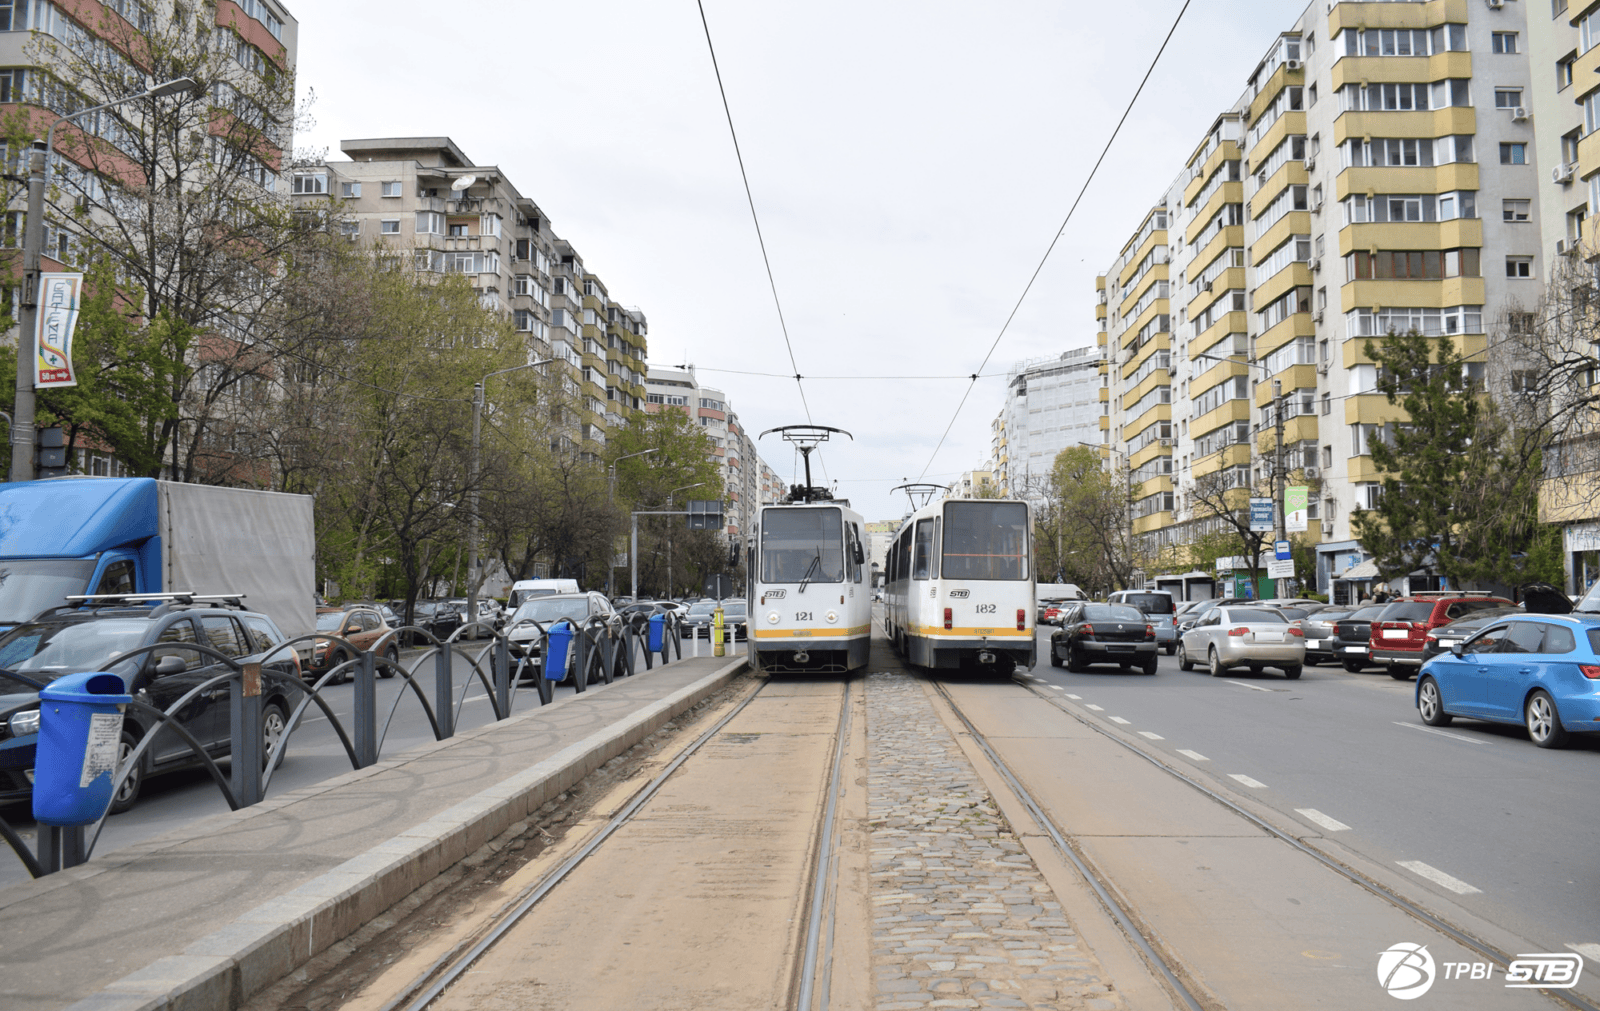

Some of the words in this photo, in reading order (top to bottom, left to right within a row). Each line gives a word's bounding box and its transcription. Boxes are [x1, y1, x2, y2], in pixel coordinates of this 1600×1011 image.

[764, 589, 786, 599] STB
[949, 589, 970, 599] STB
[975, 604, 997, 613] 182
[795, 612, 814, 621] 121
